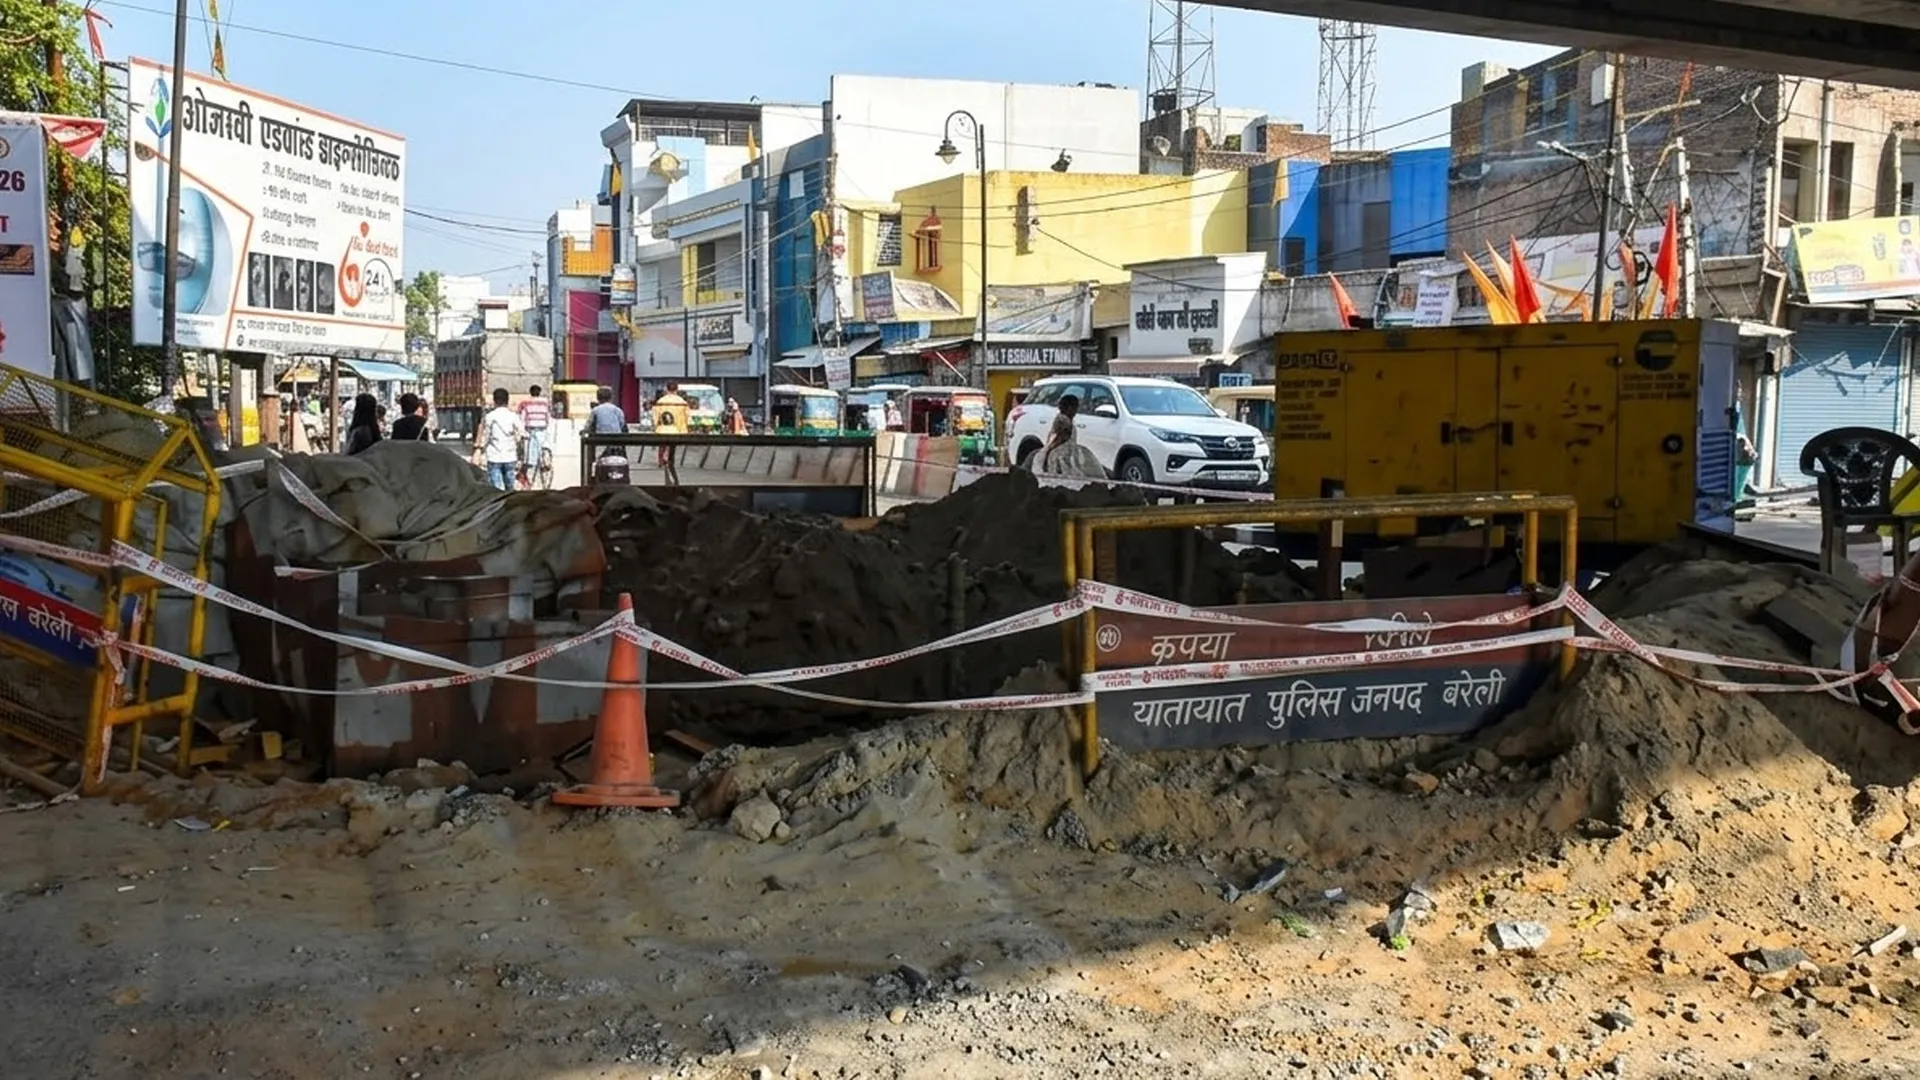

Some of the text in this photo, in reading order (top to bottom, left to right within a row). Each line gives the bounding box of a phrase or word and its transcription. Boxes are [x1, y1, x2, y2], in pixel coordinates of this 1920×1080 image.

[1132, 668, 1507, 730] यातायात पुलिस जनपद बरेली
